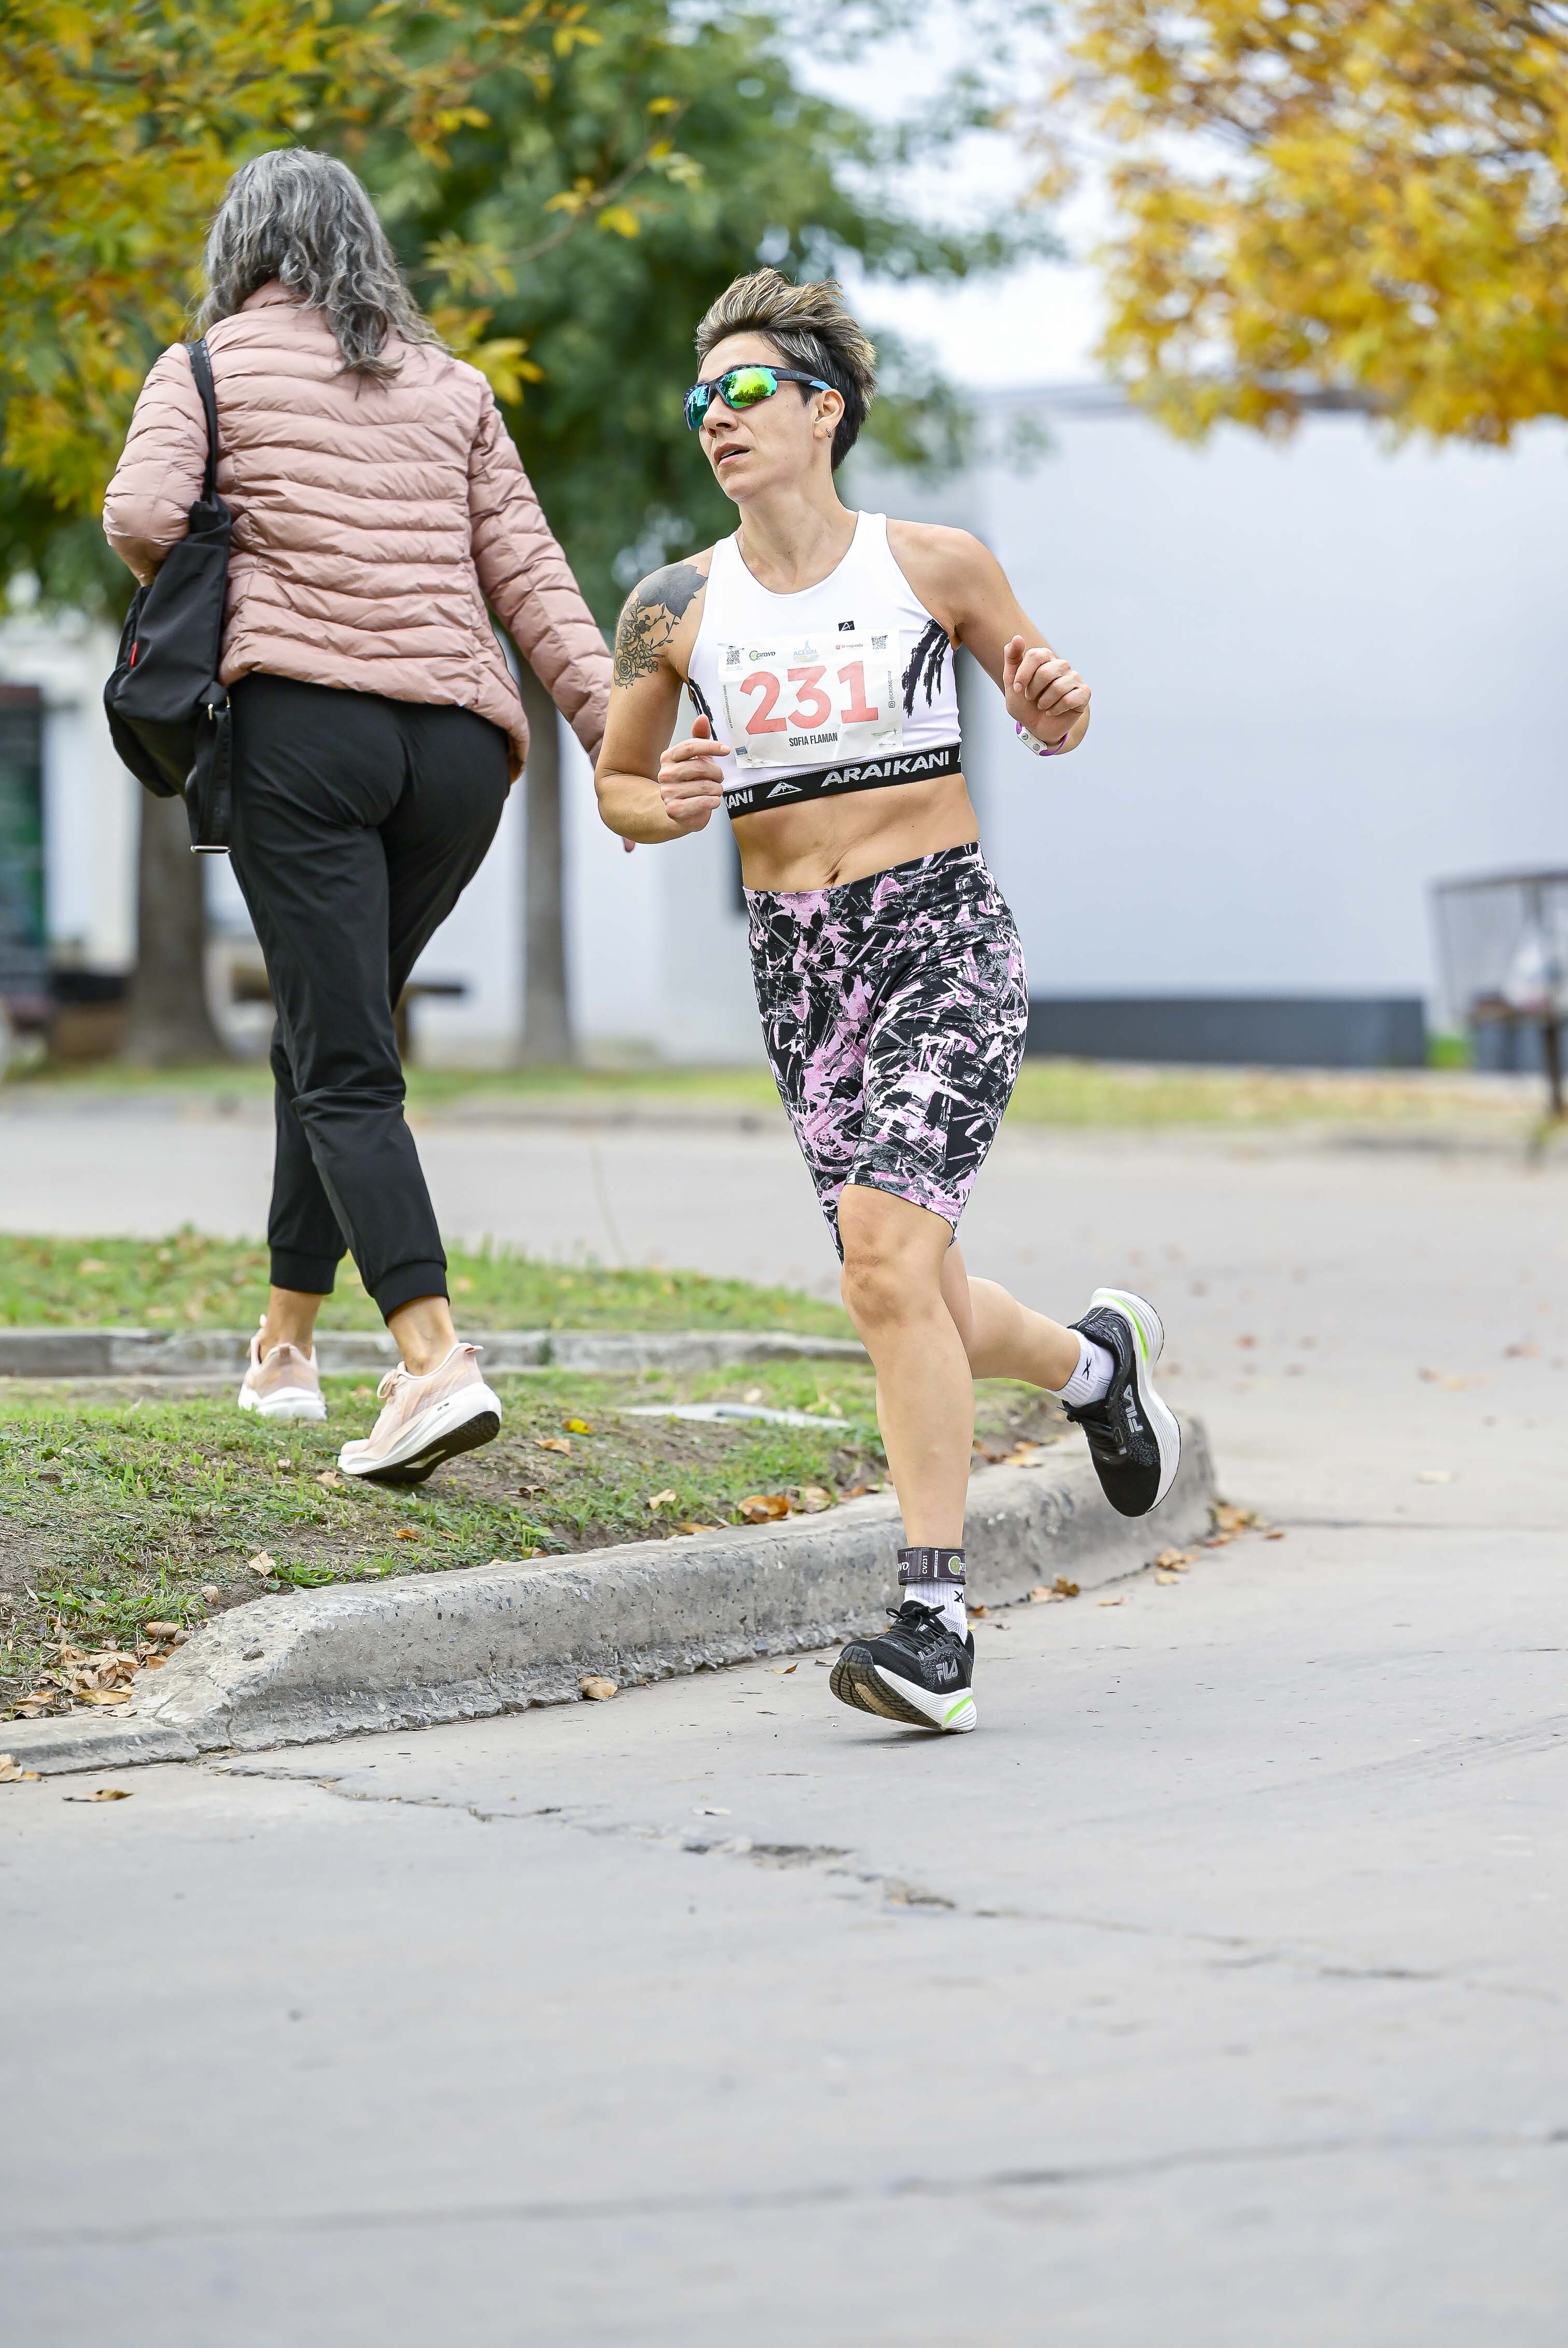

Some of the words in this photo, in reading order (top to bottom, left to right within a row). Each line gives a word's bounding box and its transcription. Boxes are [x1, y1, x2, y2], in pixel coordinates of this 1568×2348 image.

[740, 661, 878, 735] 231
[789, 736, 809, 747] SOFIA
[810, 732, 838, 744] FLAMAN
[821, 750, 949, 787] ARAIKANI
[1123, 1385, 1143, 1433] FILA
[936, 1659, 958, 1683] FILA
